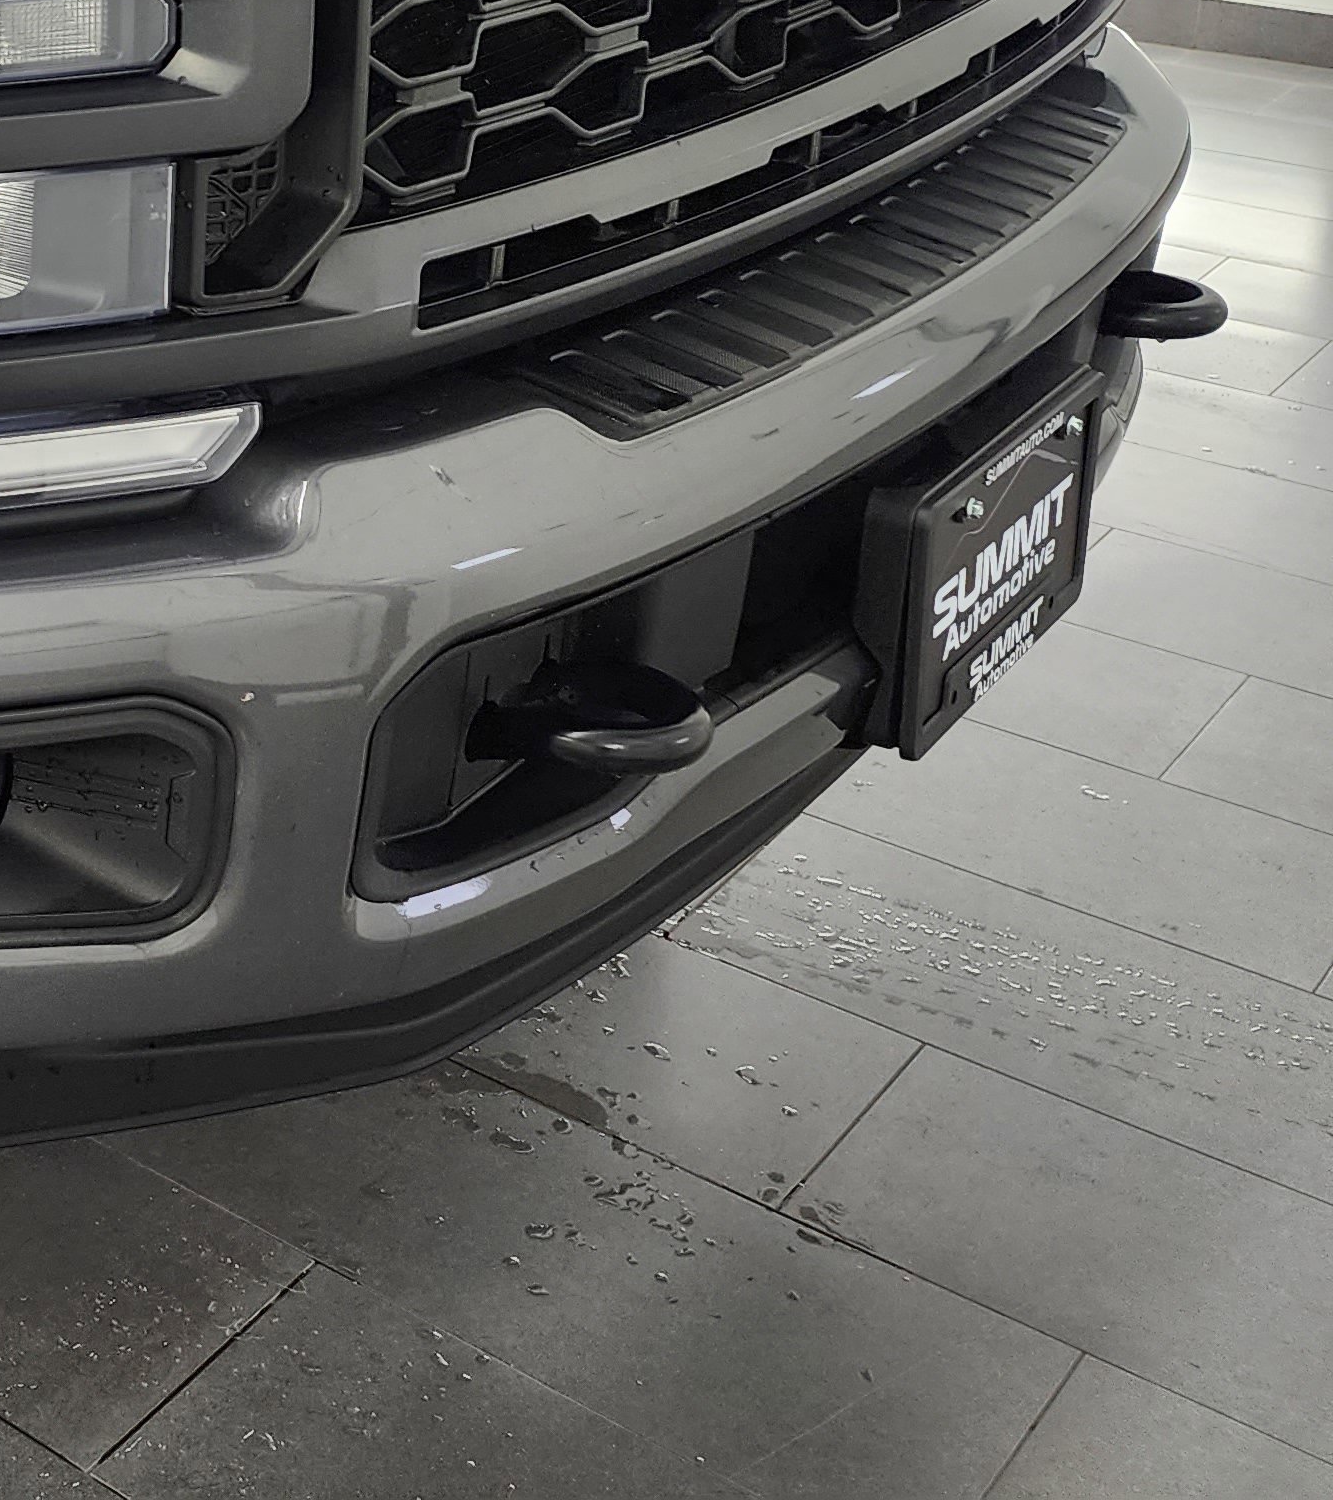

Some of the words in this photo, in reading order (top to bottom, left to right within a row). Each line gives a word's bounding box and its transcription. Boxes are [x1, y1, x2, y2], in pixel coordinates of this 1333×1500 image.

[985, 411, 1065, 486] SUMMITAUTO.COM
[932, 472, 1075, 639] SUMMIT
[942, 538, 1056, 662] Automotive
[969, 594, 1045, 689] SUMMIT
[974, 632, 1034, 702] Automotive
